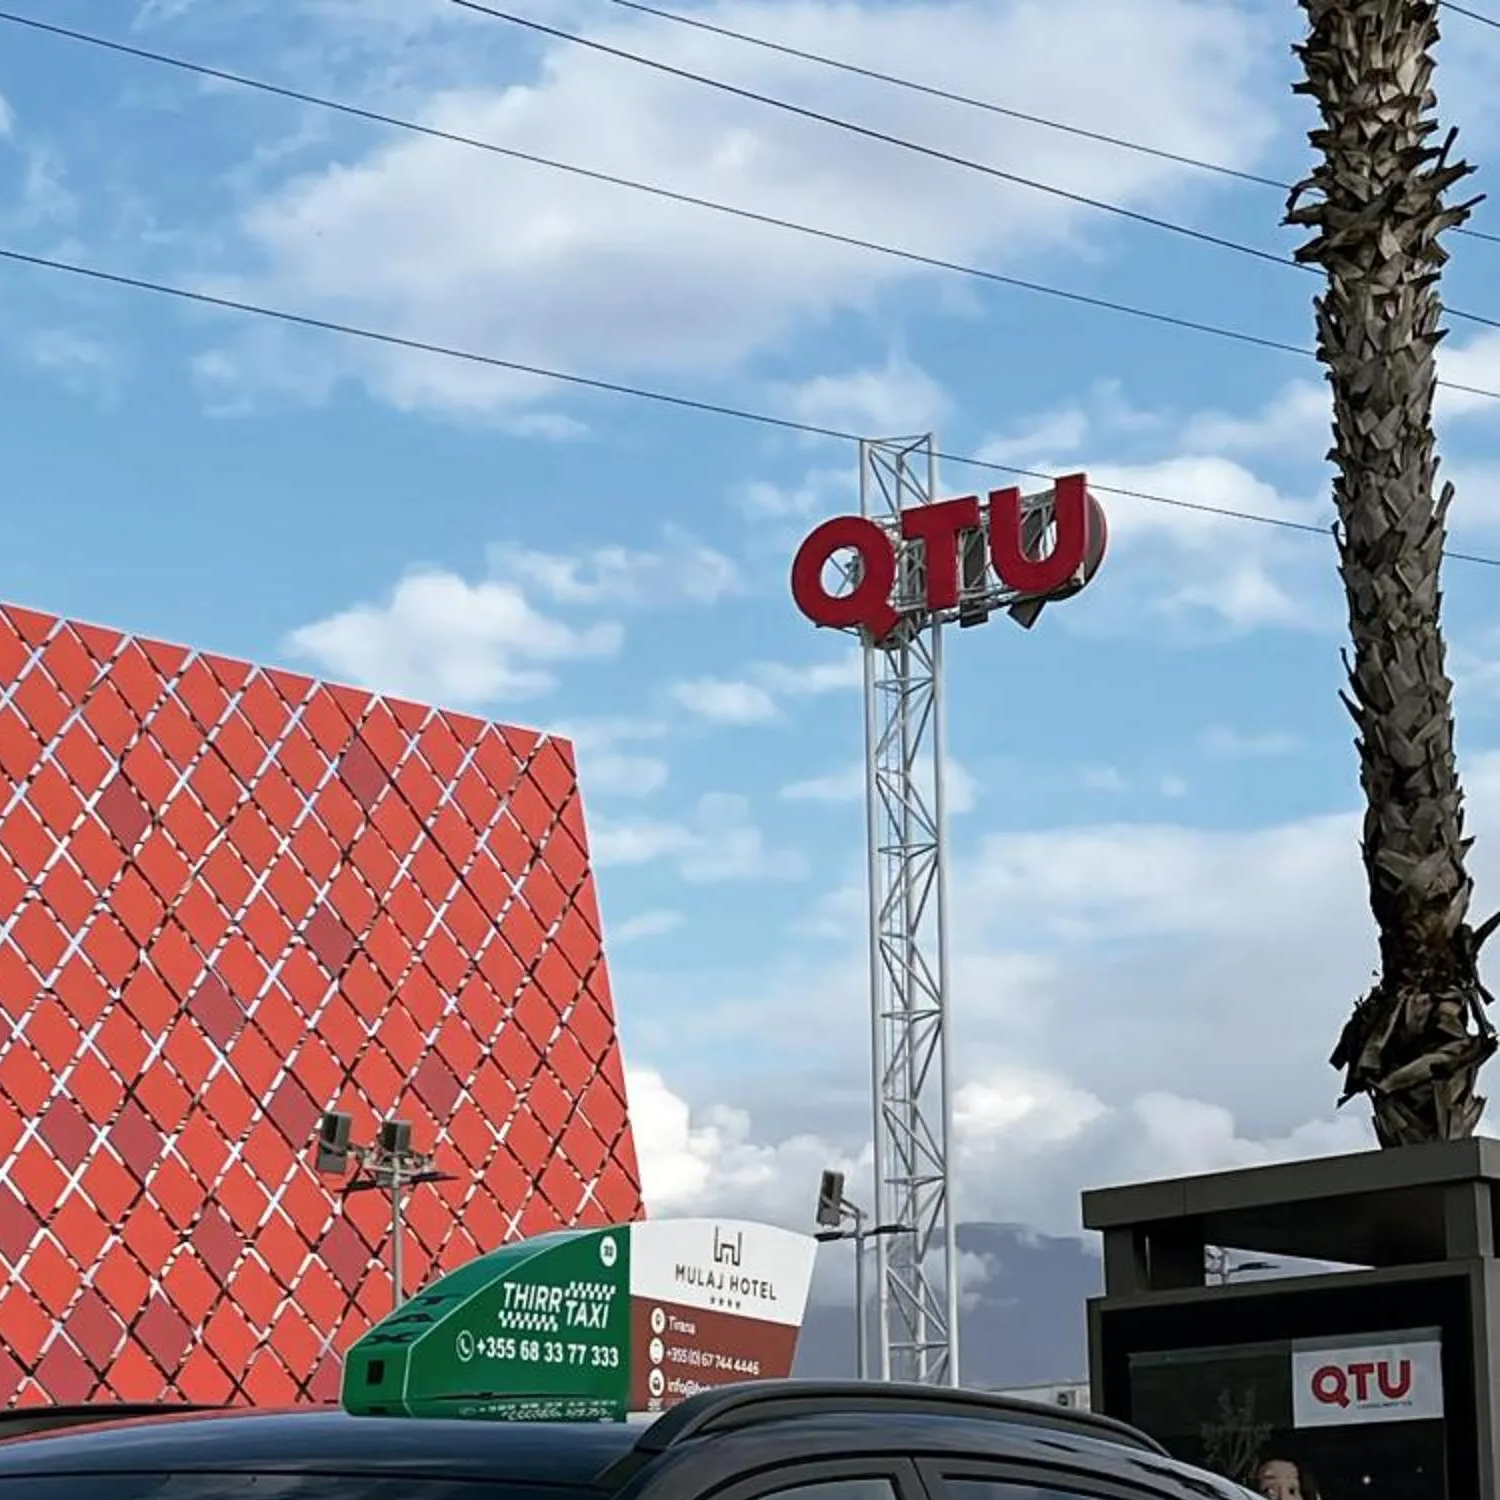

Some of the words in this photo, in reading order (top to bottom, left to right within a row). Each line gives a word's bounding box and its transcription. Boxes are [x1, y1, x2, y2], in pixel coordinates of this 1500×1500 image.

[792, 473, 1088, 641] QTU
[503, 1282, 563, 1313] THIRR
[565, 1300, 609, 1329] TAXI
[675, 1264, 725, 1290] MULAJ
[729, 1275, 777, 1300] HOTEL
[477, 1336, 516, 1360] +355
[519, 1340, 540, 1362] 68
[543, 1342, 564, 1363] 33
[567, 1344, 588, 1365] 77
[590, 1346, 620, 1368] 333
[1311, 1360, 1411, 1409] QTU
